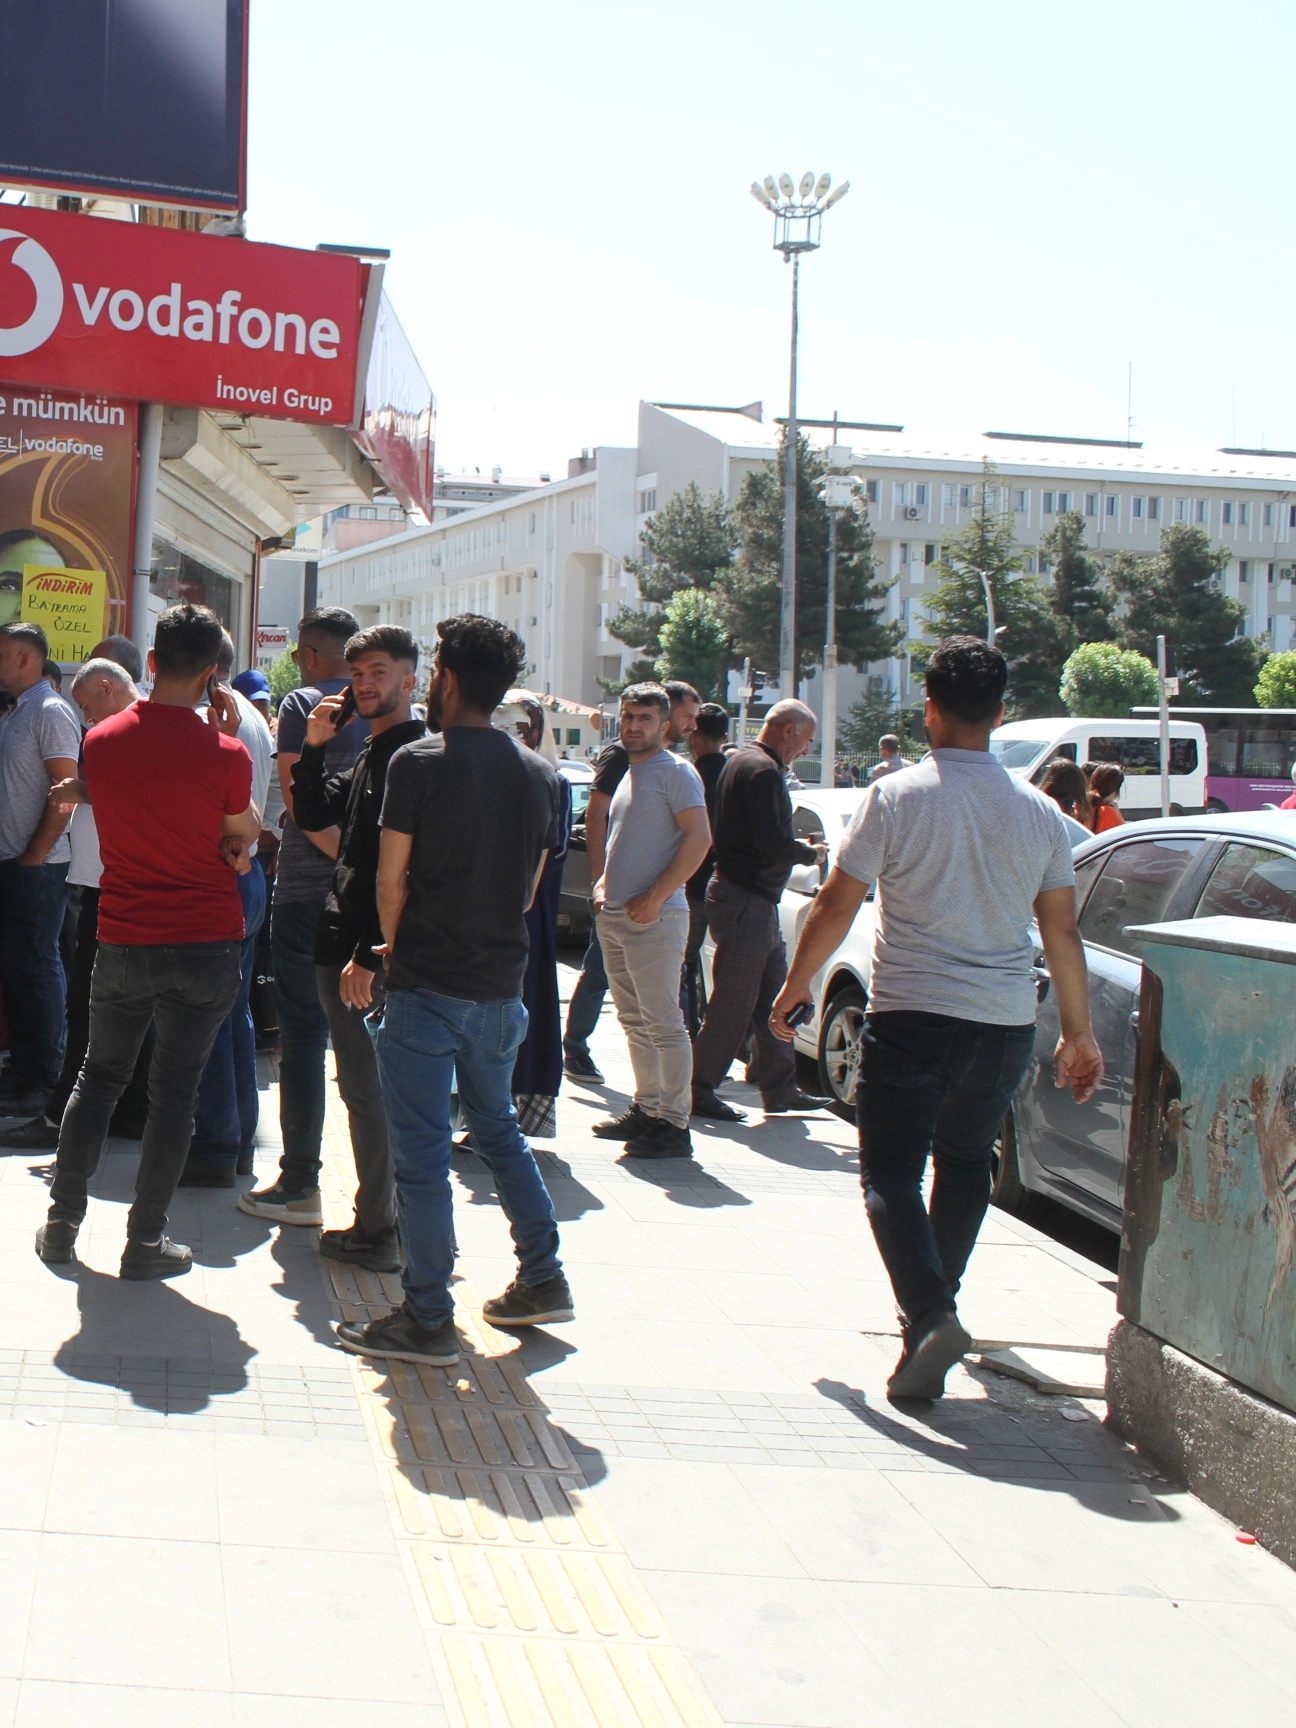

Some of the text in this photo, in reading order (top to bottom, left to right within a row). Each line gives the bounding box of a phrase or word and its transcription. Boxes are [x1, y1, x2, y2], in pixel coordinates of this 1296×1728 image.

[72, 282, 341, 360] vodafone
[13, 393, 125, 426] mümkün
[217, 375, 333, 416] İnovel Grup
[24, 437, 104, 457] vodafone
